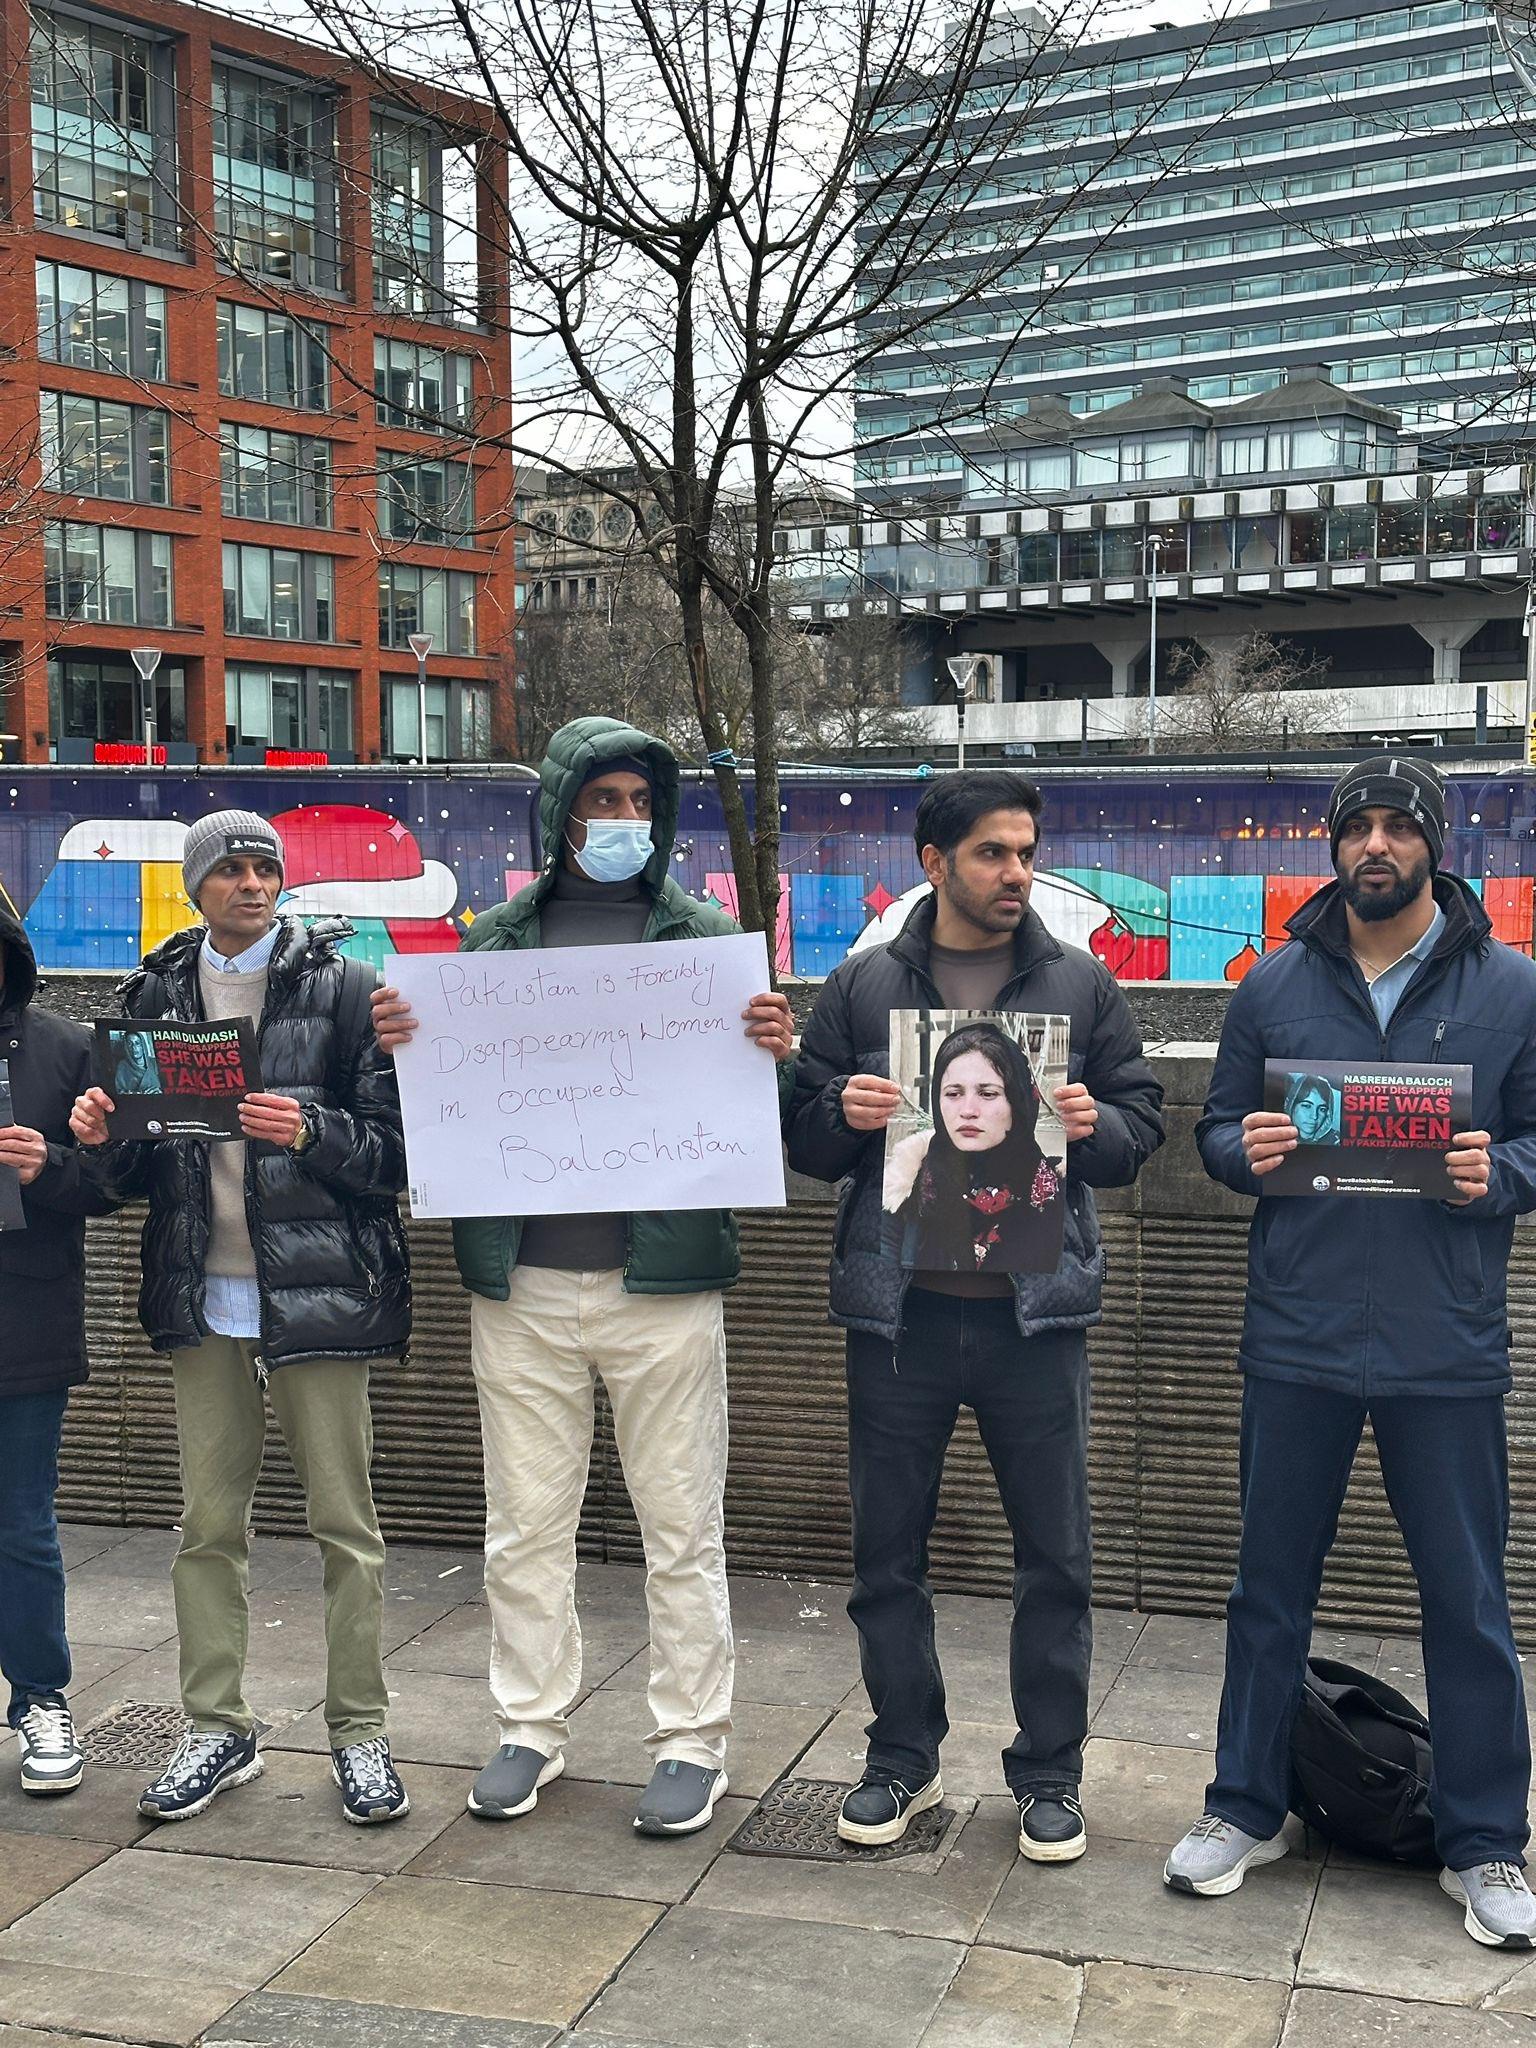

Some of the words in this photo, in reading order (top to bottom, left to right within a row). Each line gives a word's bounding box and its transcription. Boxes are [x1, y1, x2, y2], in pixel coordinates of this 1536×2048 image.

[94, 743, 167, 764] BARBURRTO
[438, 963, 580, 1016] Pakistan
[595, 971, 616, 994] is
[626, 956, 715, 1007] Forcibly
[153, 1030, 182, 1041] HANI
[182, 1029, 238, 1043] DILWASH
[187, 1041, 240, 1052] DISAPPEAR
[430, 1027, 634, 1082] Disappearing
[157, 1050, 192, 1066] SHE
[193, 1051, 241, 1066] WAS
[162, 1068, 245, 1088] TAKEN
[1344, 1075, 1405, 1086] NASREENA
[1405, 1077, 1453, 1087] BALOCH
[1344, 1085, 1364, 1094] DID
[1365, 1086, 1389, 1095] NOT
[1389, 1086, 1453, 1096] DISAPPEAR
[440, 1098, 467, 1122] in
[1344, 1096, 1390, 1113] SHE
[1395, 1097, 1451, 1114] WAS
[1345, 1116, 1450, 1139] TAKEN
[1342, 1139, 1356, 1148] BY
[1356, 1139, 1410, 1149] PAKISTANI
[1410, 1140, 1451, 1149] FORCES
